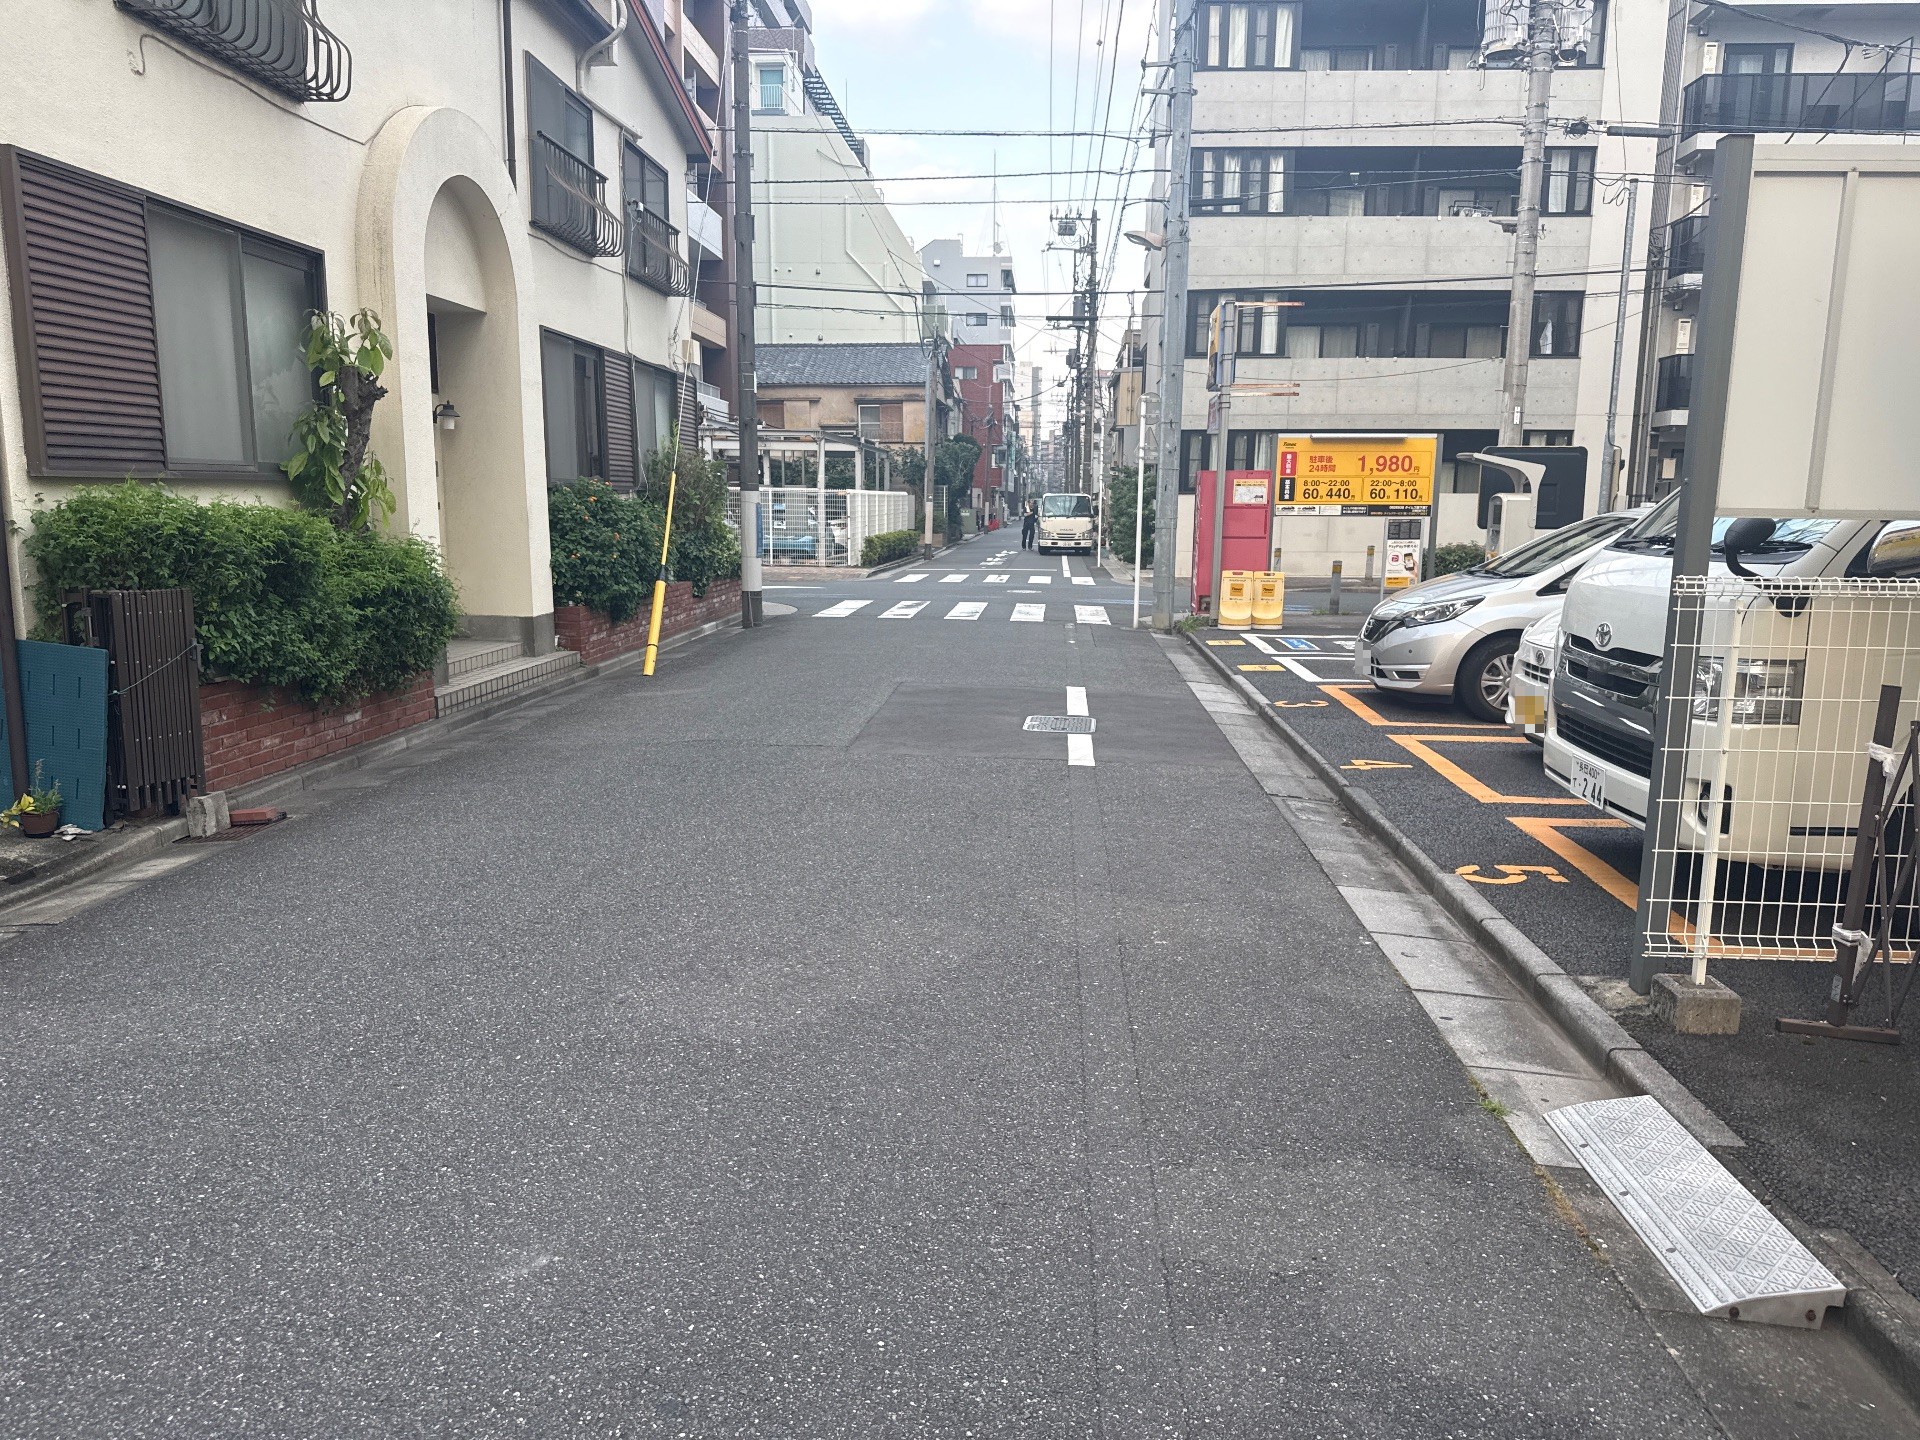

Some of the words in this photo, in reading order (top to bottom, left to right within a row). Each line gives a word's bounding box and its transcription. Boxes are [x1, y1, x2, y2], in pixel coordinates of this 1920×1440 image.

[1309, 455, 1333, 464] 駐車後
[1308, 464, 1336, 473] 24時間
[1340, 760, 1413, 770] 4
[1454, 864, 1570, 886] 5
